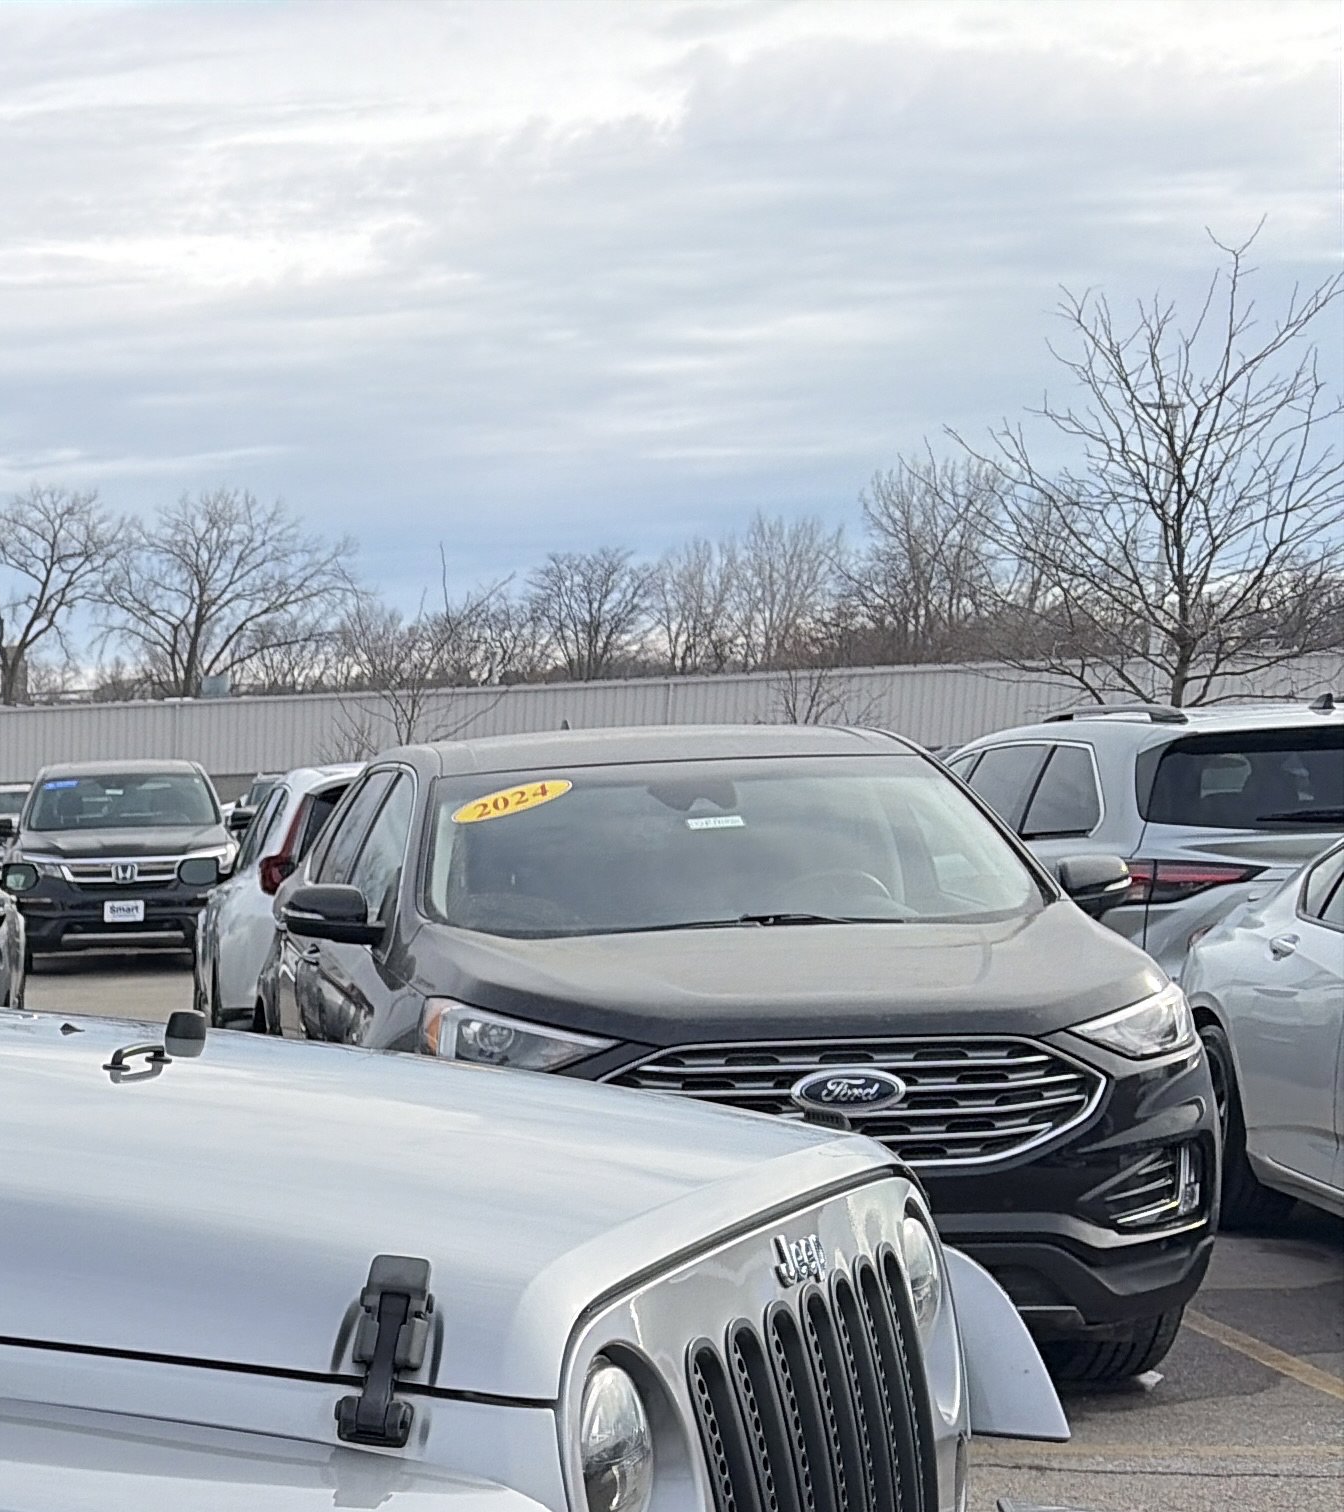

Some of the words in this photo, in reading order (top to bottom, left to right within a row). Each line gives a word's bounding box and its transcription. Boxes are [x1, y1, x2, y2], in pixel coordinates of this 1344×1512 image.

[474, 783, 550, 819] 2024
[109, 904, 139, 914] Smart
[821, 1079, 880, 1101] Ford
[771, 1234, 826, 1288] Jeep
